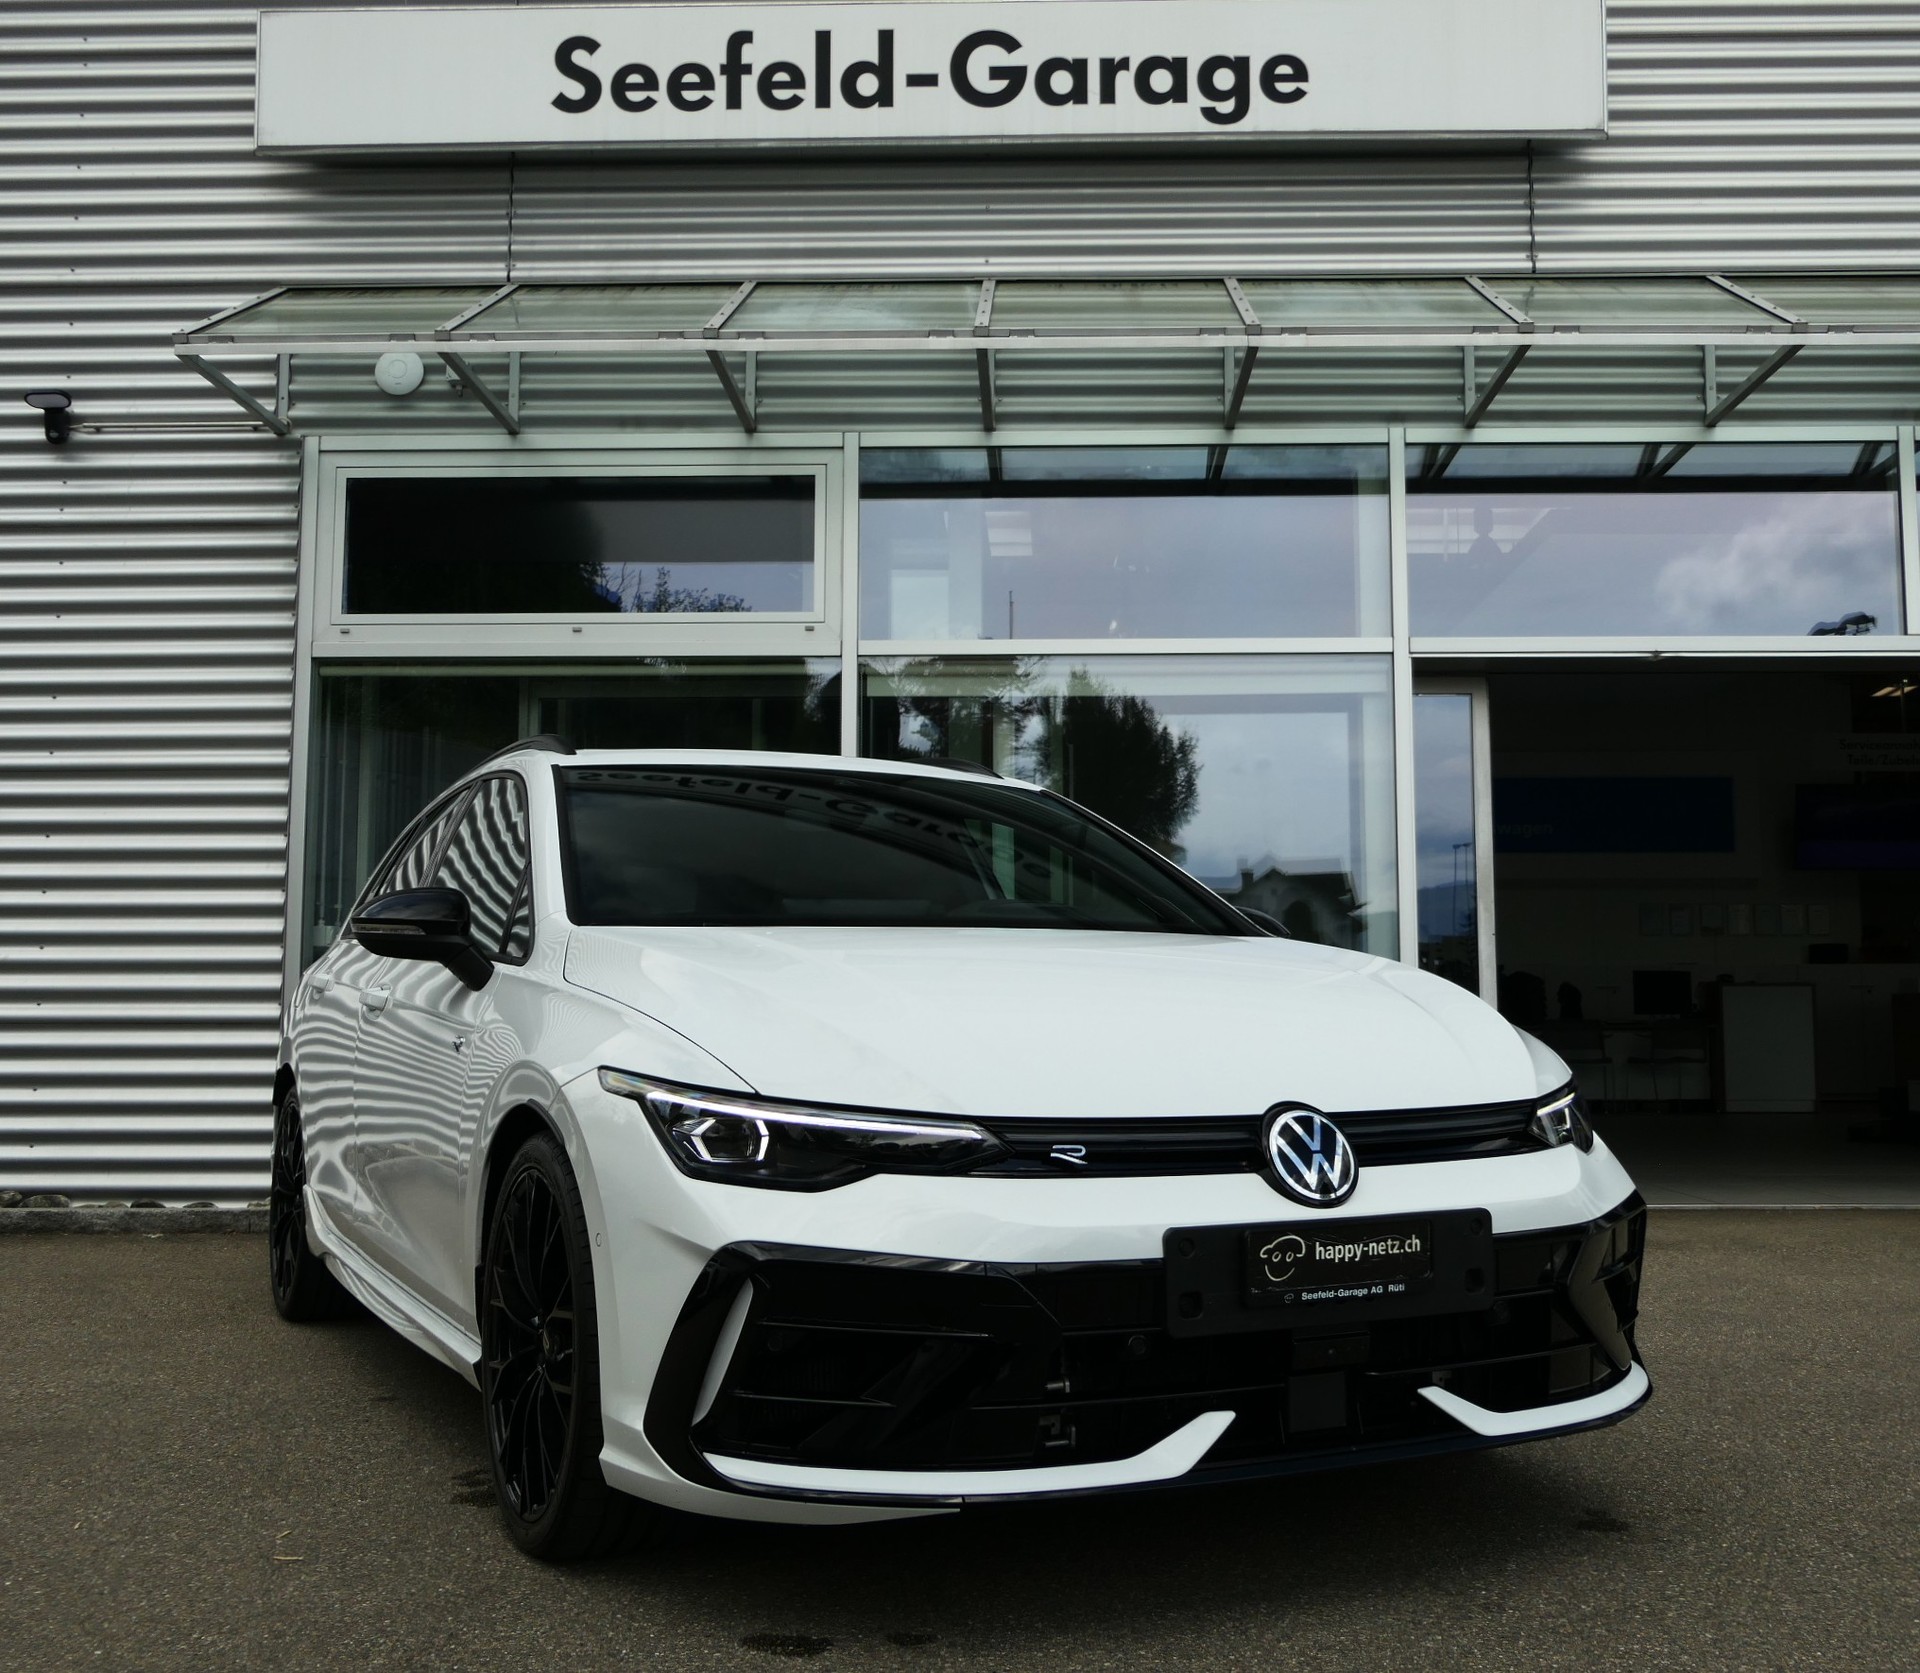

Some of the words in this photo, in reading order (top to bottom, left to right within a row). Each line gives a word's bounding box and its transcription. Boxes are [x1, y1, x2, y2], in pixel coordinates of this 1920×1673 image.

[550, 29, 1310, 126] Seefeld-Garage
[1314, 1234, 1421, 1263] happy-netz.ch
[1301, 1287, 1368, 1301] Seefeld-Garage
[1370, 1284, 1383, 1294] AG
[1388, 1282, 1405, 1293] Rüti
